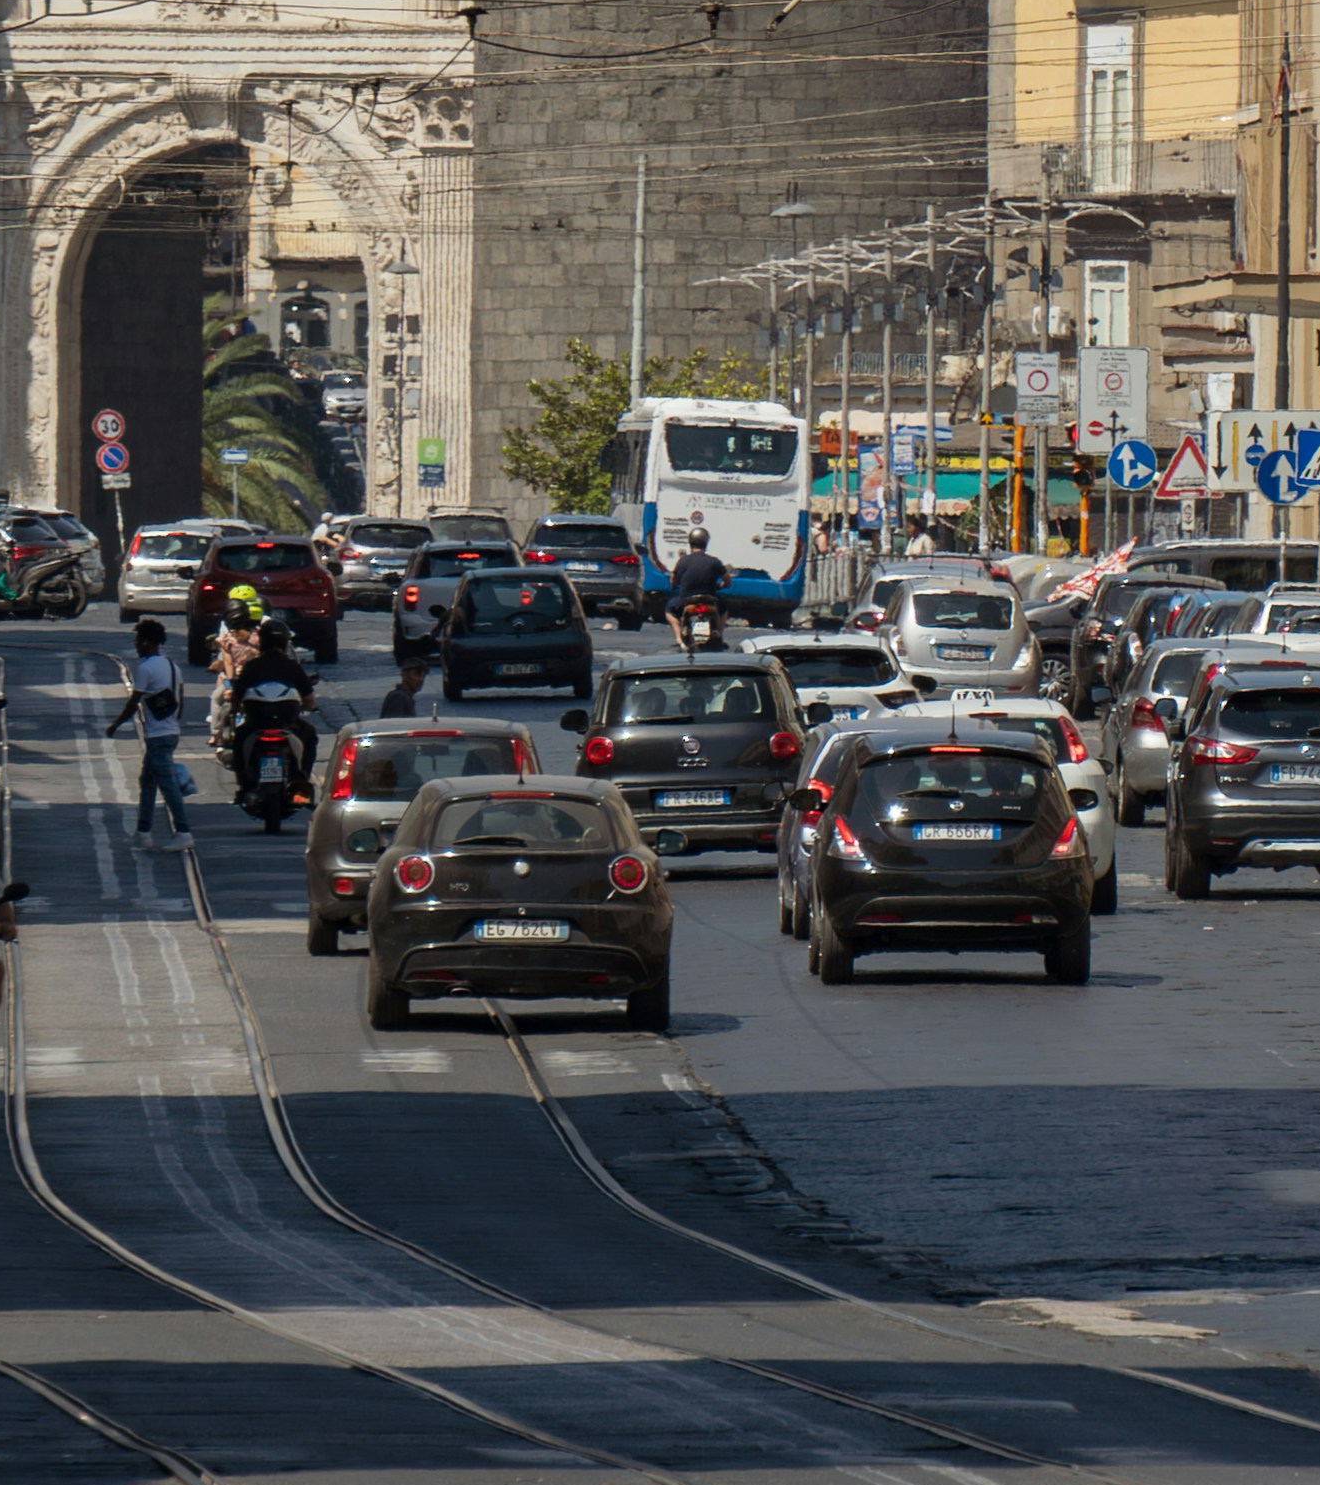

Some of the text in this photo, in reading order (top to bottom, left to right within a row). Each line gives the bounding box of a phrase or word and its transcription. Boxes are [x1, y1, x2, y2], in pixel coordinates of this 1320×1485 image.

[100, 418, 120, 434] 30
[958, 691, 992, 701] TAXI
[486, 920, 505, 936] EG
